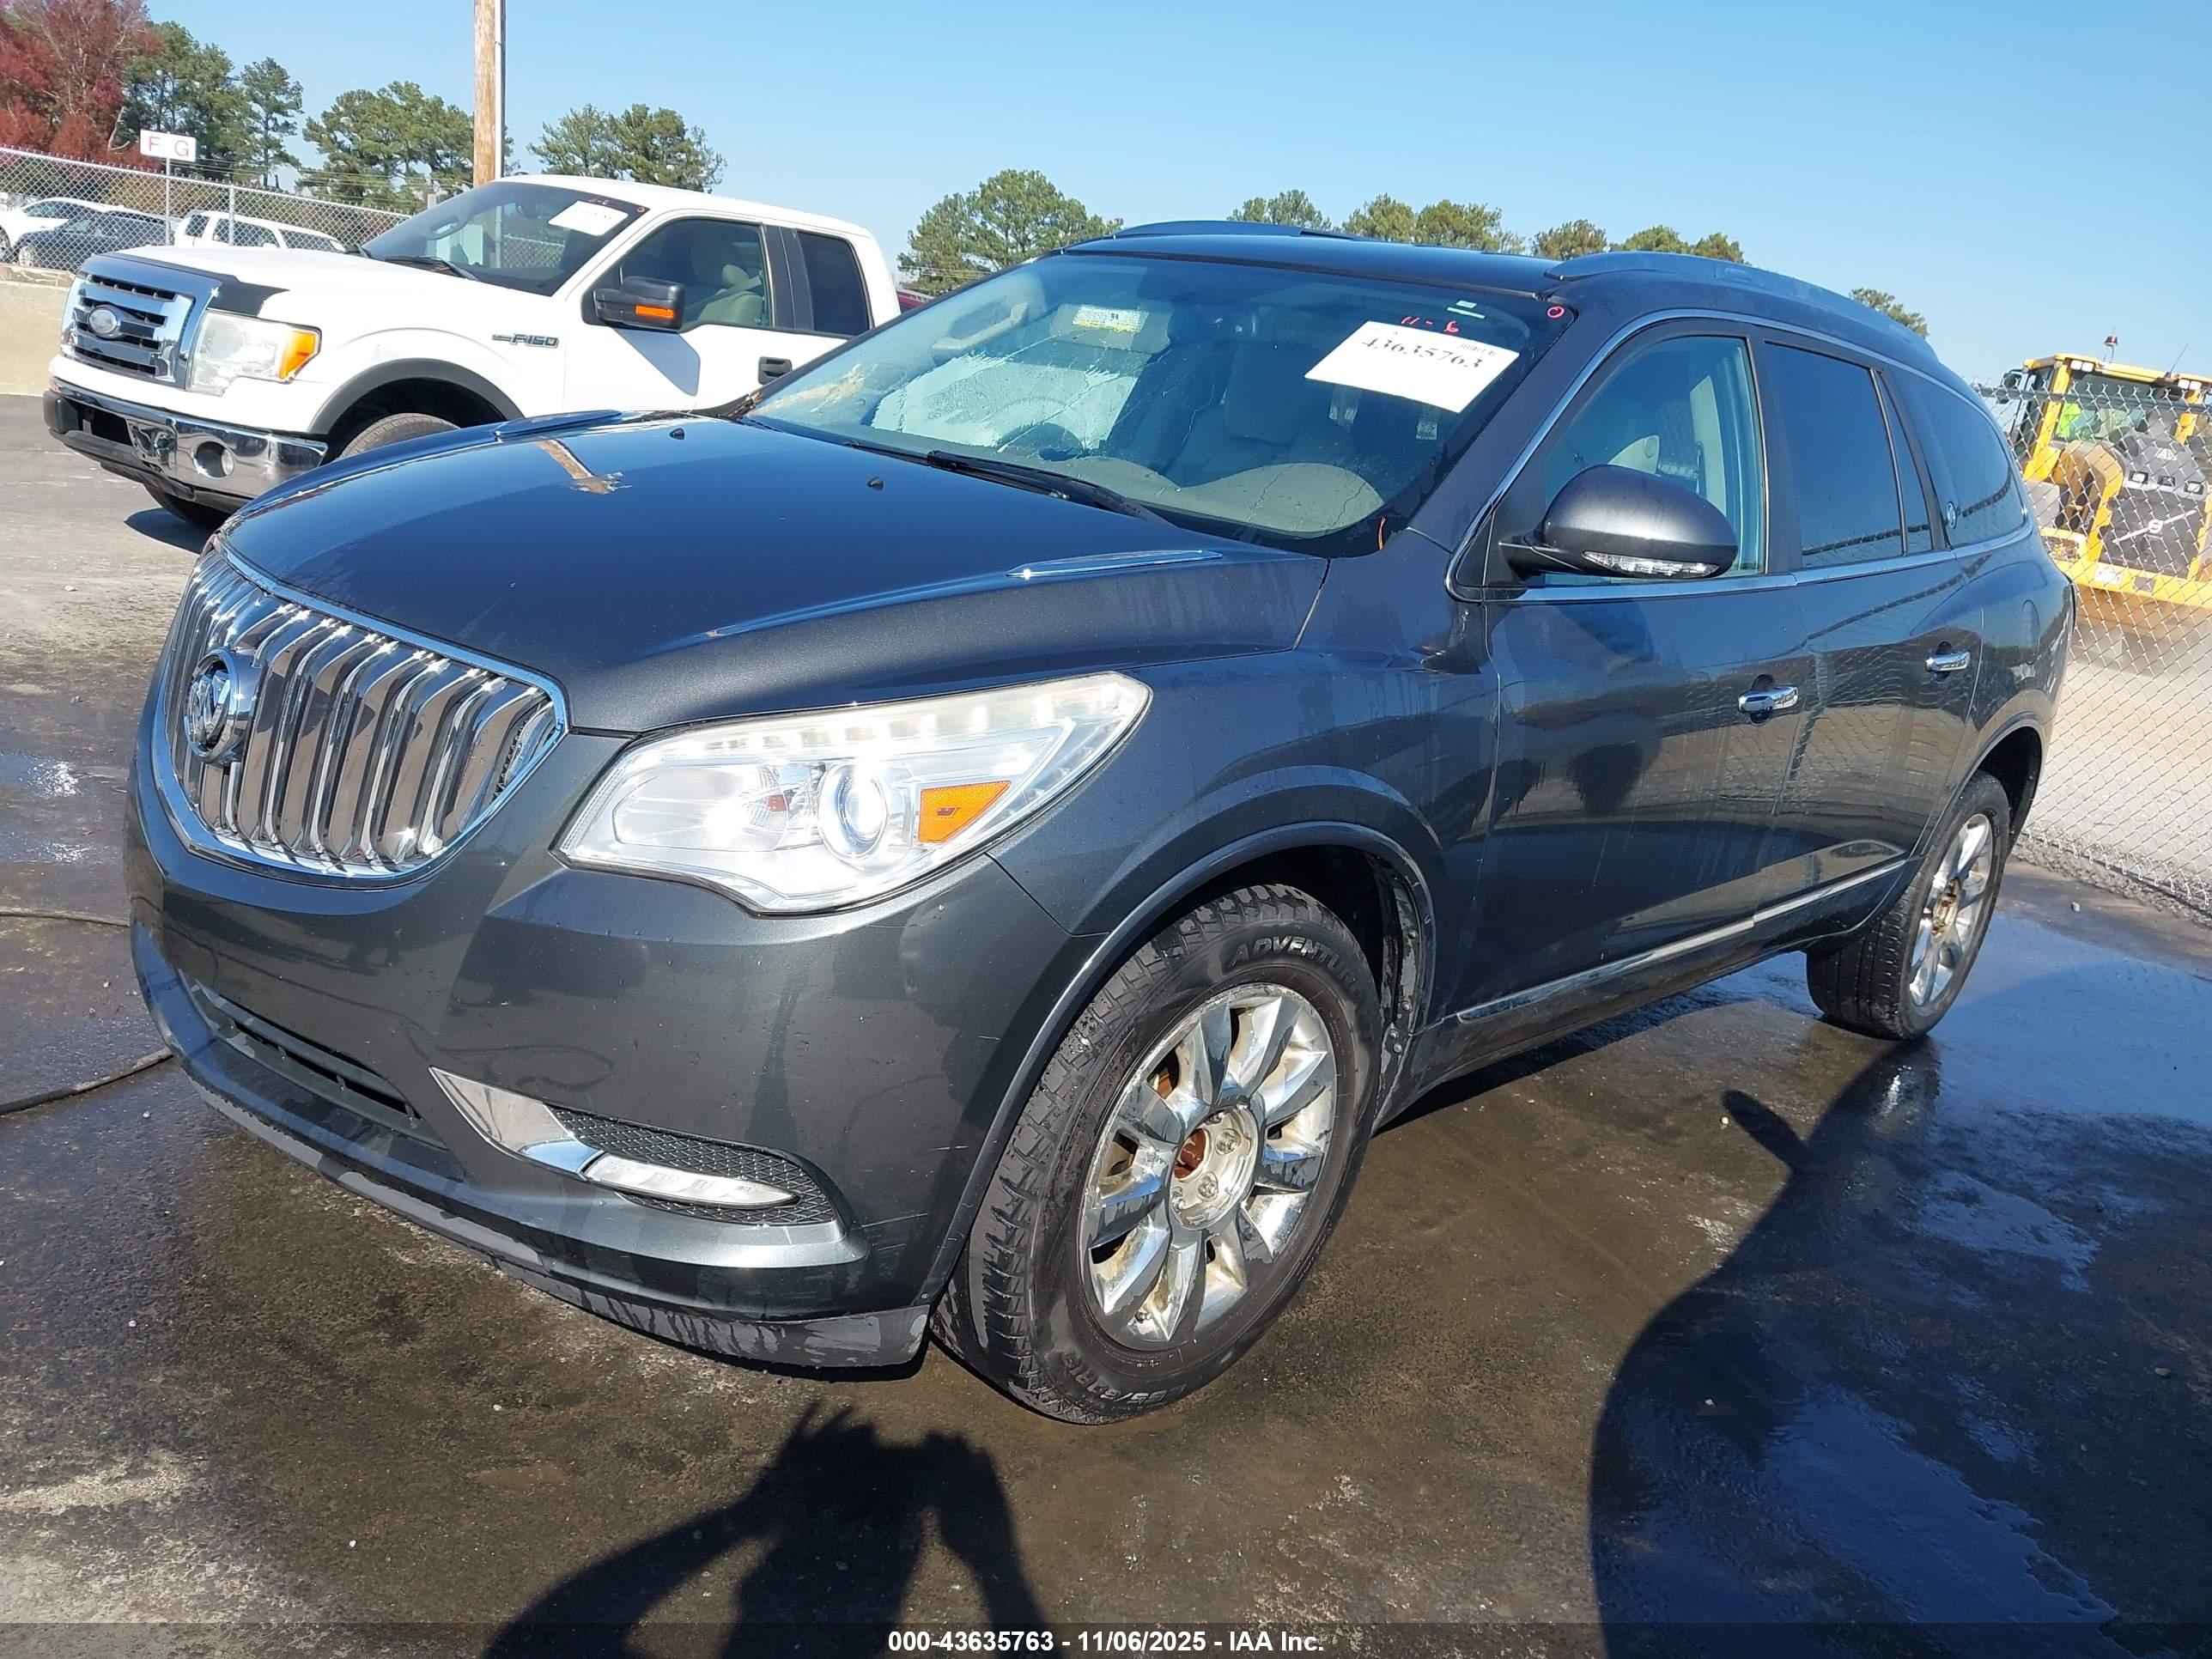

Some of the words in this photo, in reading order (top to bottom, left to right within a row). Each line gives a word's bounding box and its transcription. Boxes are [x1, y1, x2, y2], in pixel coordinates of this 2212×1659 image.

[149, 136, 161, 151] F
[173, 139, 190, 158] G
[1362, 338, 1483, 368] 43635763
